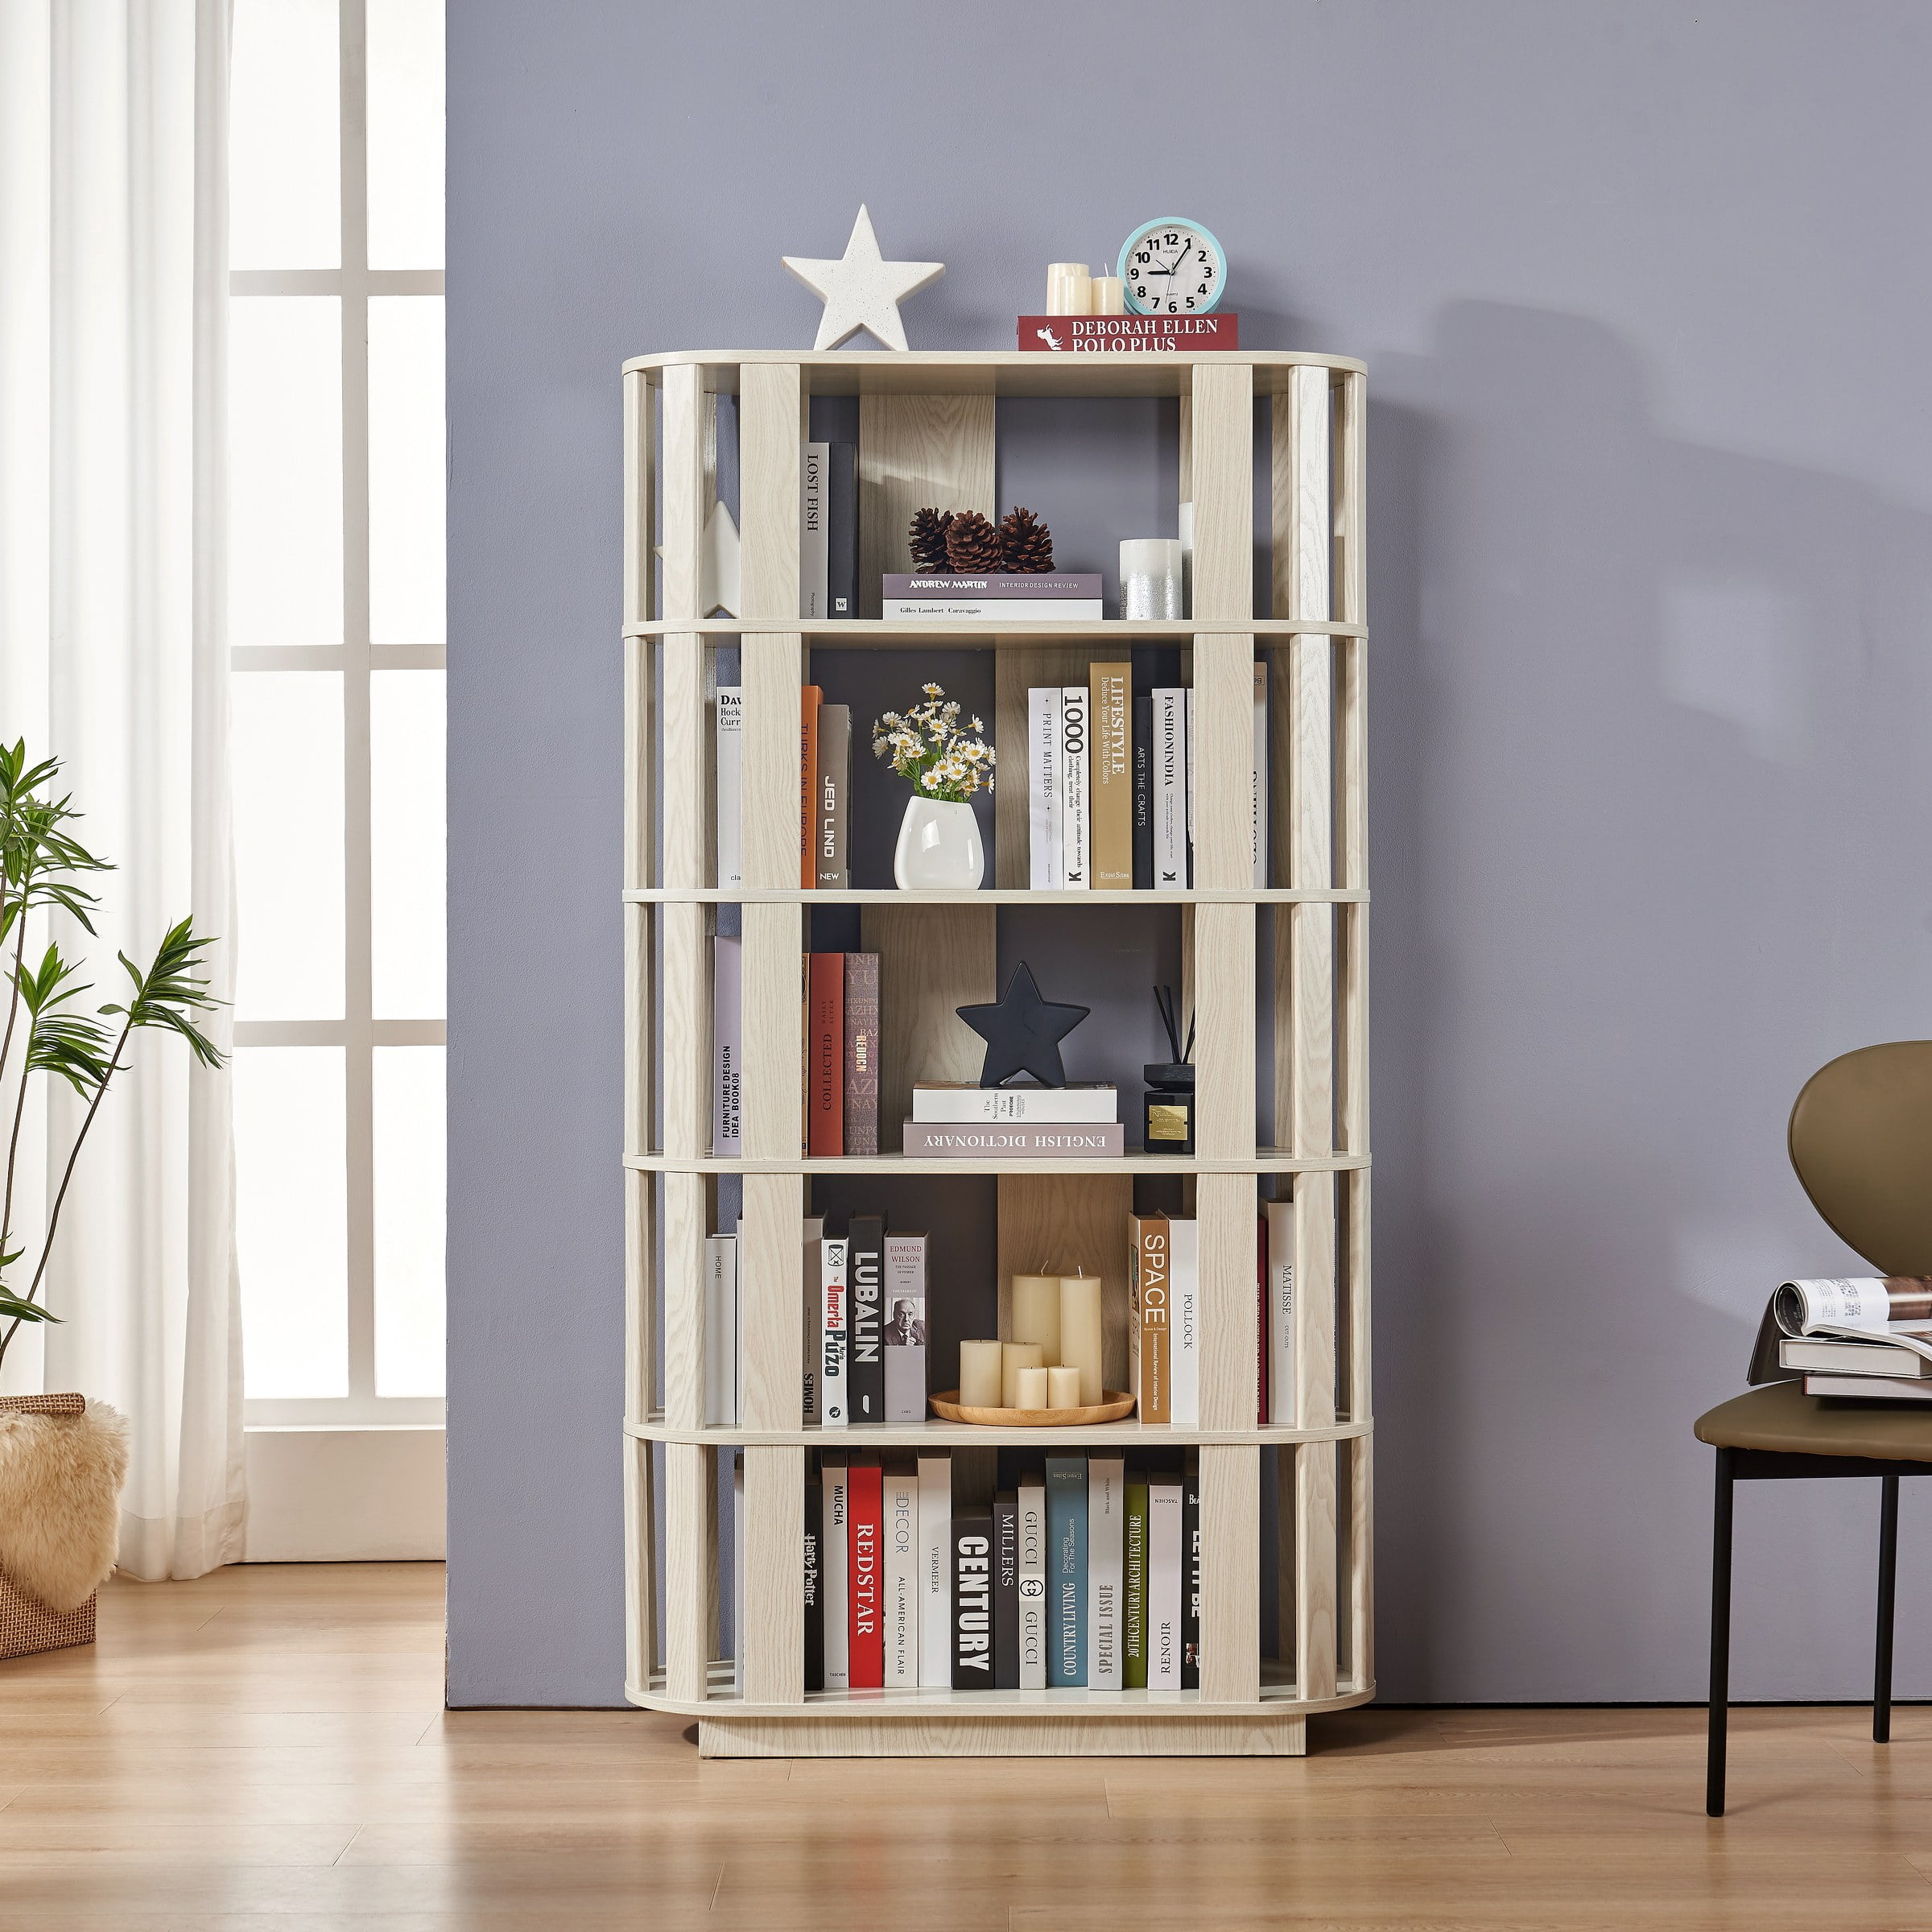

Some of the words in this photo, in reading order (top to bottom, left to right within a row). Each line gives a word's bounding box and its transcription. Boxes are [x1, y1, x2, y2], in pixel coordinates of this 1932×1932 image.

[1146, 239, 1160, 250] 11
[1163, 233, 1179, 246] 12
[1185, 238, 1191, 250] 1
[1135, 252, 1150, 263] 10
[1198, 250, 1207, 262] 2
[1203, 266, 1212, 278] 3
[1130, 268, 1139, 280] 9
[1197, 283, 1208, 295] 4
[1137, 286, 1146, 298] 8
[1151, 297, 1160, 309] 7
[1168, 301, 1177, 313] 6
[1186, 297, 1195, 308] 5
[1072, 320, 1157, 336] DEBORAH
[1163, 319, 1218, 335] ELLEN
[1072, 338, 1125, 351] POLO
[1129, 336, 1176, 351] PLUS
[807, 454, 819, 493] LOST
[807, 497, 819, 531] FISH
[909, 580, 951, 588] ANDREW
[952, 580, 988, 588] MARTIN
[1101, 677, 1109, 704] Deduce
[720, 708, 741, 716] Hock
[1064, 696, 1084, 753] 1000
[1101, 705, 1109, 724] Your
[1111, 676, 1125, 774] LIFESTYLE
[1043, 713, 1052, 745] PRINT
[1102, 724, 1110, 739] Life
[1165, 696, 1174, 786] FASHIONINDIA
[1102, 741, 1110, 759] With
[1137, 747, 1146, 769] ARTS
[1043, 752, 1053, 798] MATTERS
[1102, 759, 1111, 785] Colors
[1137, 773, 1146, 790] THE
[824, 775, 836, 811] JED
[1137, 794, 1146, 826] CRAFTS
[824, 818, 835, 858] LIND
[819, 873, 840, 881] NEW
[1069, 872, 1081, 881] K
[1162, 871, 1175, 881] K
[823, 1034, 832, 1111] COLLECTED
[923, 1135, 1026, 1147] DICTIONARY
[1035, 1135, 1106, 1147] ENGLISH
[1144, 1234, 1166, 1324] SPACE
[1282, 1265, 1292, 1315] MATISSE
[828, 1286, 844, 1327] Omerta
[854, 1252, 879, 1362] LUBALIN
[1184, 1294, 1193, 1349] POLLOCK
[824, 1330, 847, 1377] Puzo
[804, 1373, 814, 1414] HOMES
[834, 1485, 843, 1525] MUCHA
[896, 1498, 909, 1553] DECOR
[1025, 1511, 1038, 1565] GUCCI
[805, 1533, 815, 1569] Harry
[1002, 1513, 1014, 1587] MILLERS
[1129, 1514, 1141, 1590] ARCHITECTURE
[805, 1569, 817, 1606] Potter
[857, 1523, 875, 1636] REDSTAR
[958, 1536, 989, 1671] CENTURY
[1062, 1582, 1075, 1621] LIVING
[1099, 1585, 1113, 1618] ISSUE
[1025, 1611, 1038, 1665] GUCCI
[1063, 1623, 1076, 1676] COUNTRY
[1099, 1624, 1113, 1674] SPECIAL
[1161, 1621, 1170, 1674] RENOIR
[897, 1649, 905, 1674] FLAIR
